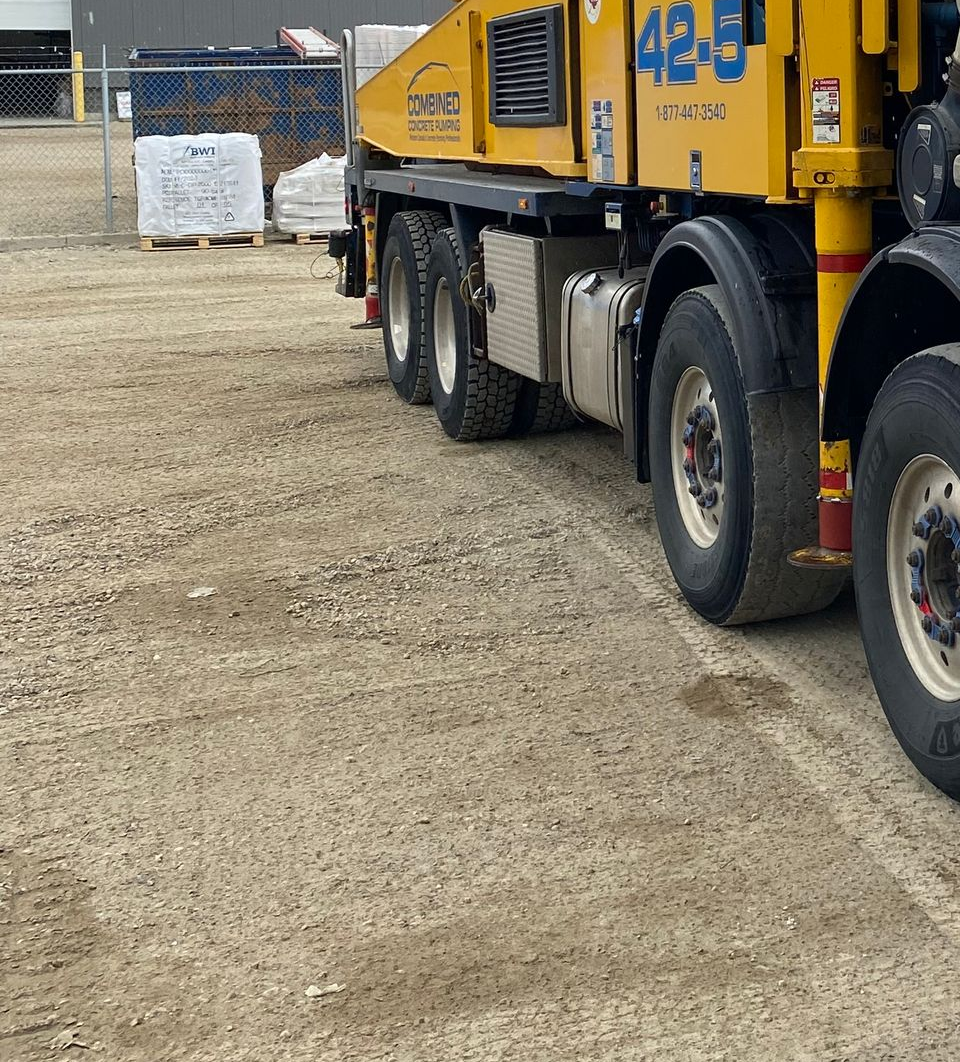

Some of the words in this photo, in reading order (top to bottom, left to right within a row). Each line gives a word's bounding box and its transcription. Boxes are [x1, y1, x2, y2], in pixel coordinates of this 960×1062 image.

[407, 91, 461, 116] COMBINED
[655, 103, 726, 121] 1-877-447-3540
[407, 119, 434, 132] CONCRETE
[435, 119, 461, 132] PUMPING
[190, 147, 216, 155] BWI
